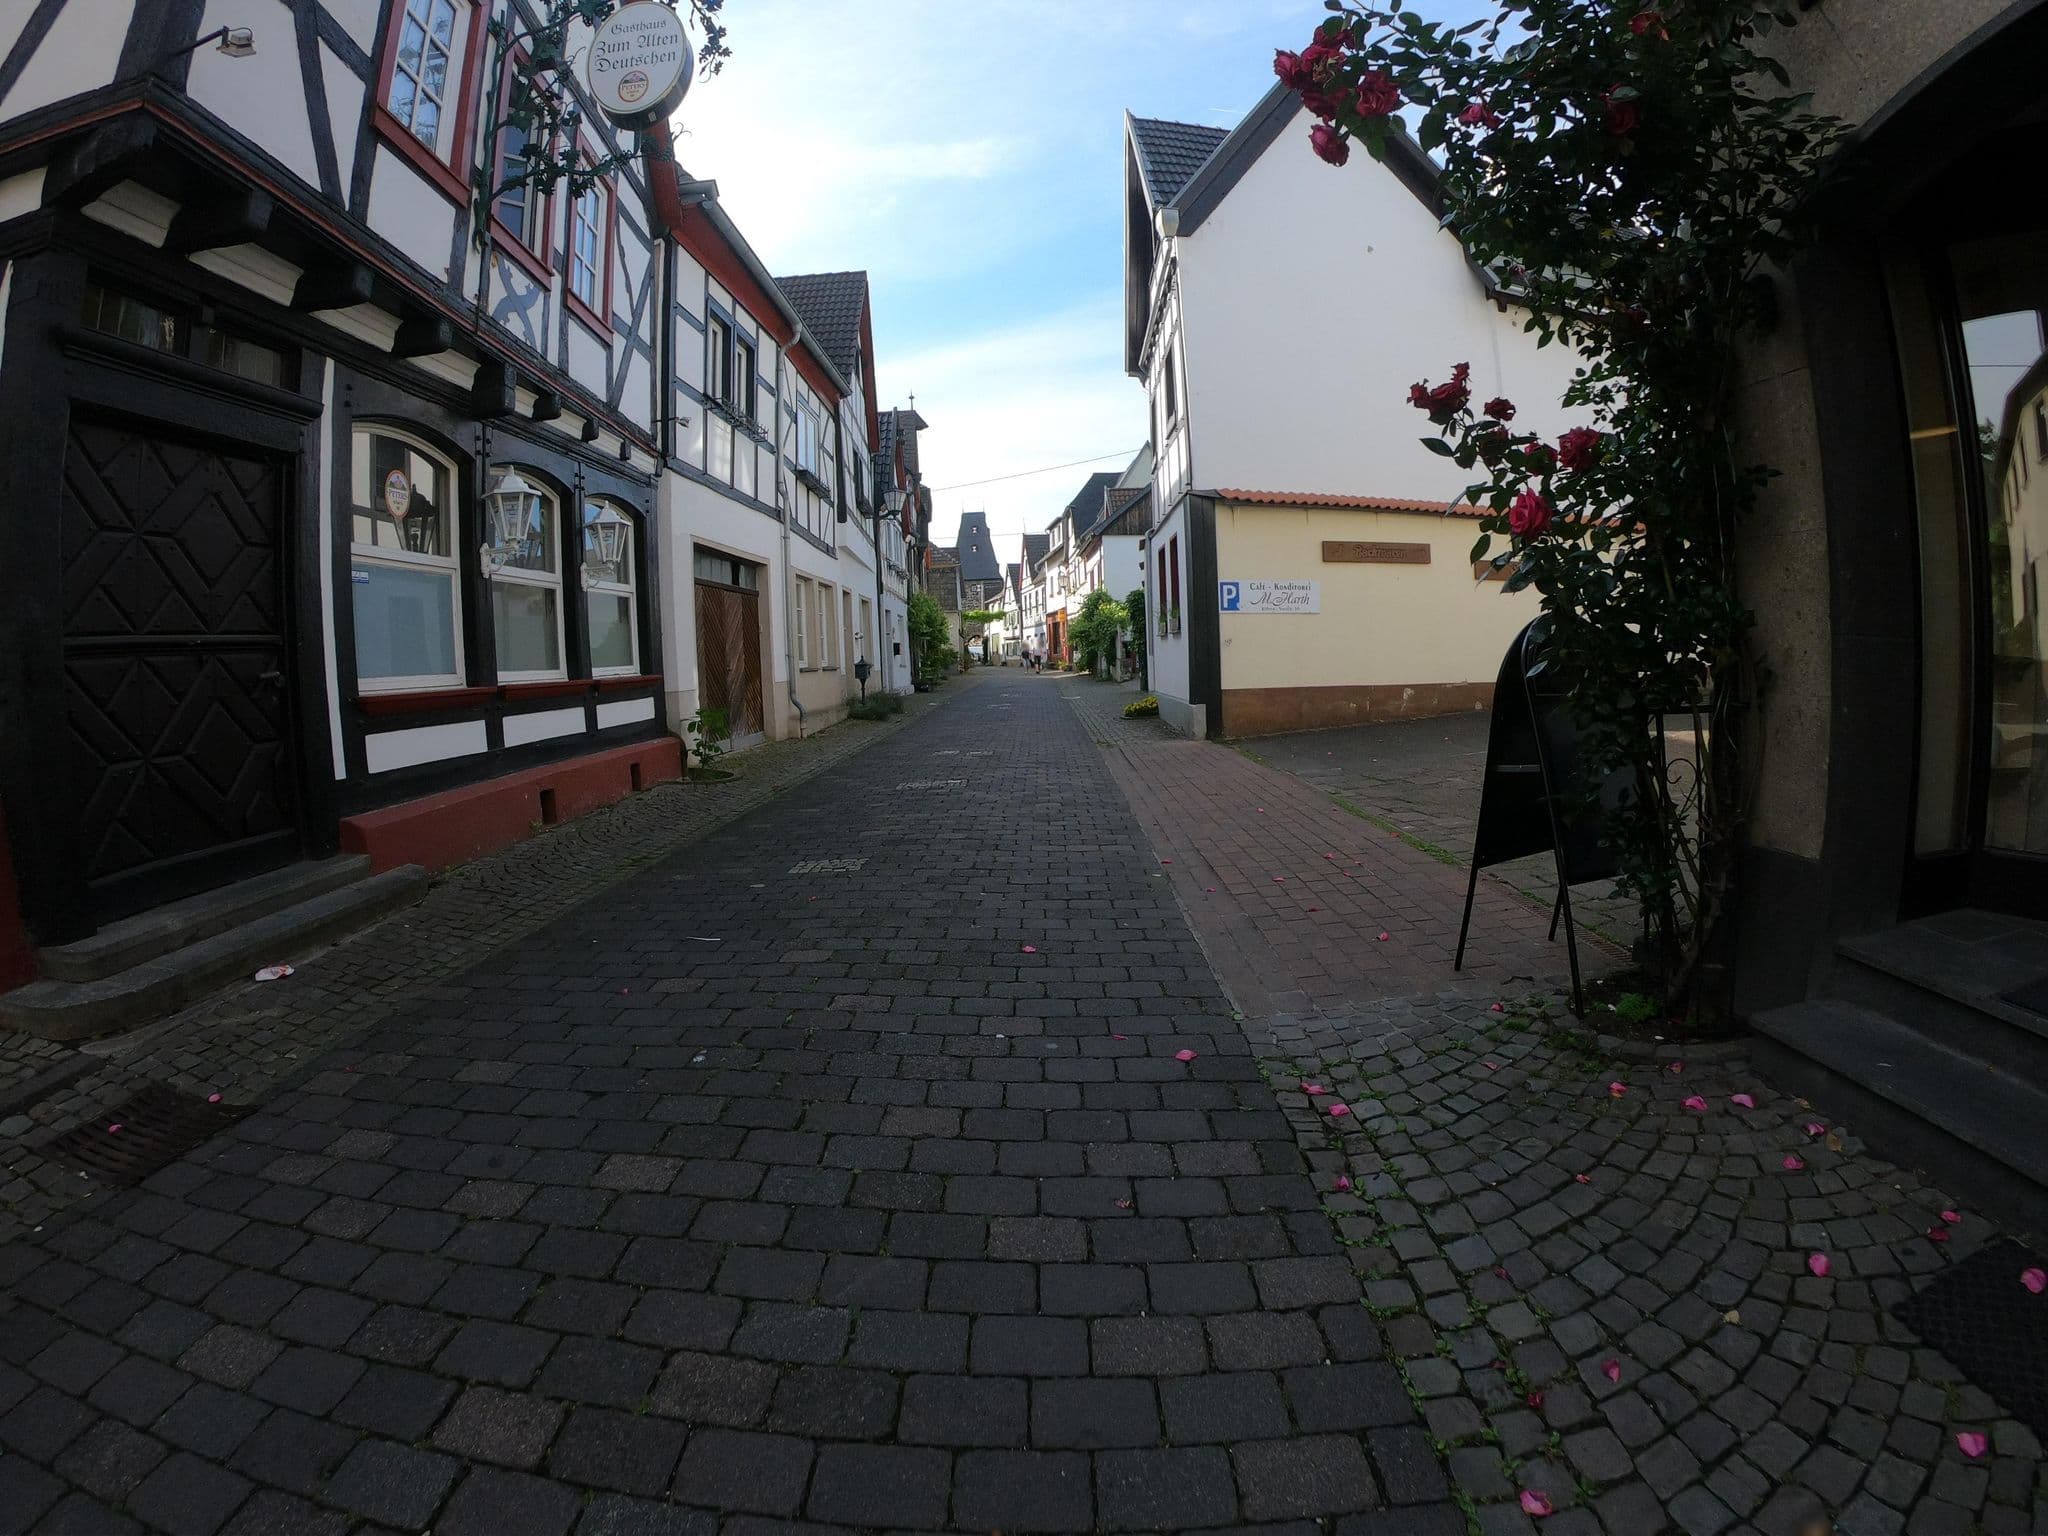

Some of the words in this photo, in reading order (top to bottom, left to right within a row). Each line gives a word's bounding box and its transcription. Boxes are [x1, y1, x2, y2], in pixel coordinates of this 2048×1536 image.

[611, 19, 667, 35] Gasthaus
[596, 41, 630, 58] Zum
[637, 34, 678, 48] Alten
[595, 51, 676, 72] Deutschen
[1223, 584, 1236, 608] P
[1274, 582, 1311, 590] Konditorei
